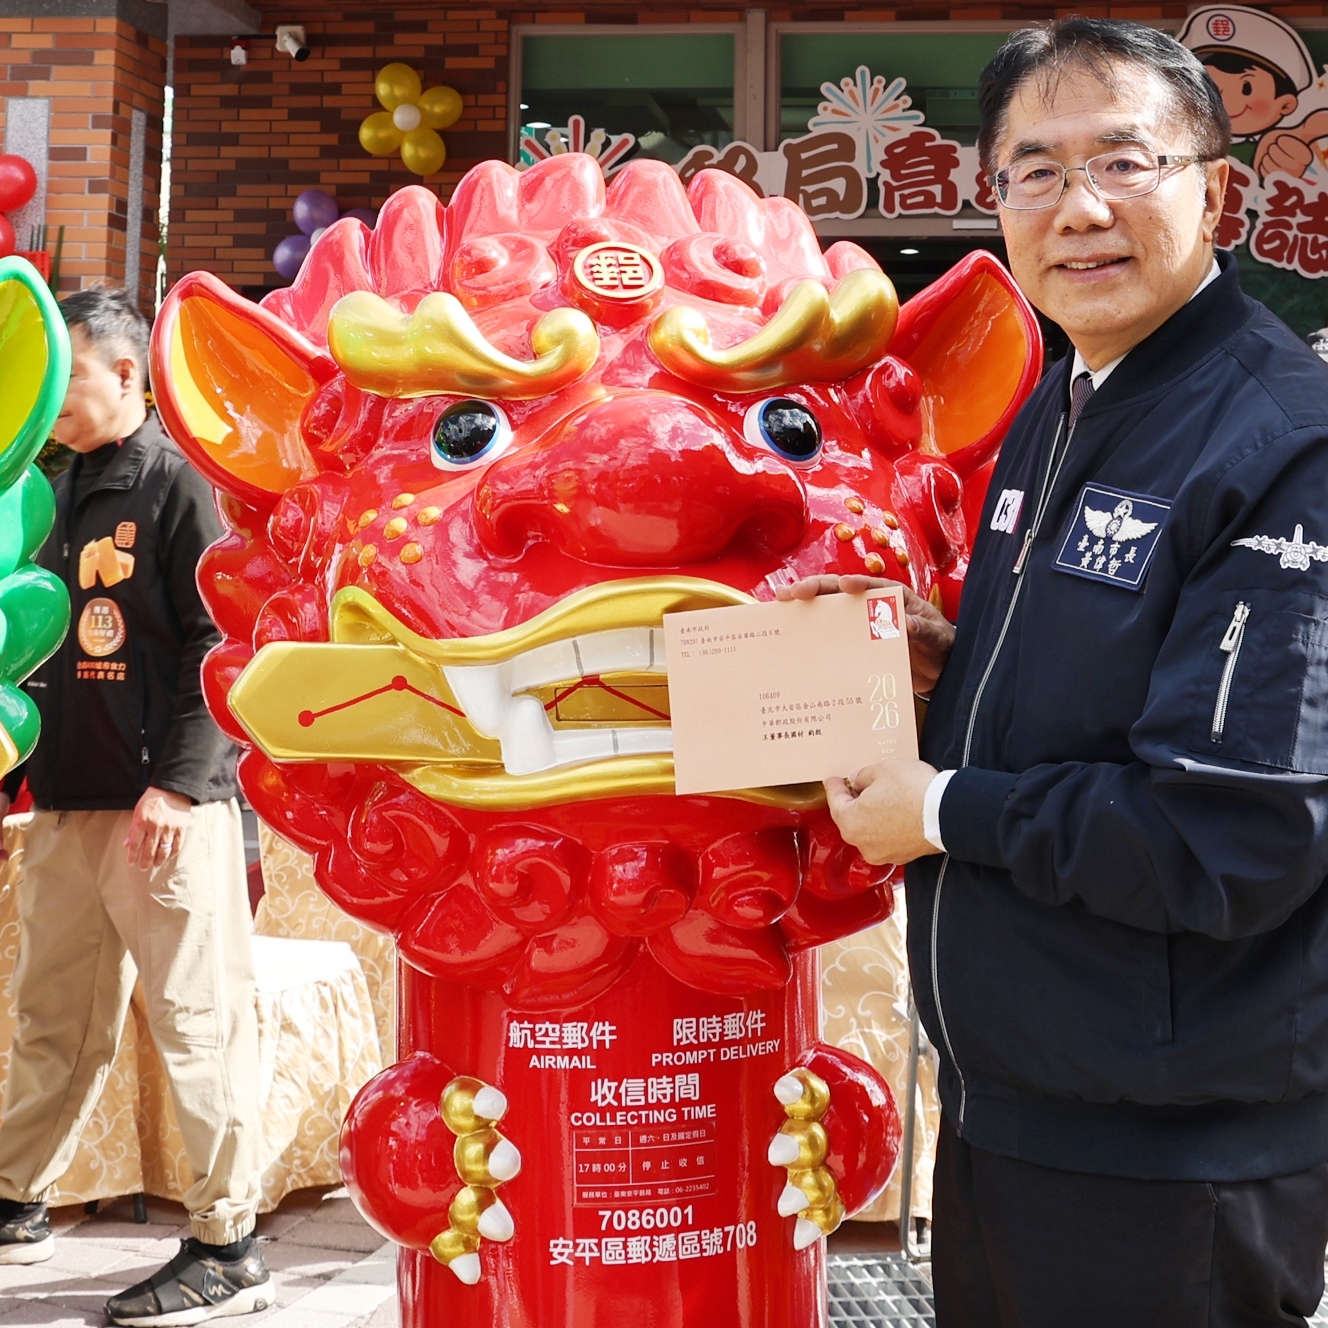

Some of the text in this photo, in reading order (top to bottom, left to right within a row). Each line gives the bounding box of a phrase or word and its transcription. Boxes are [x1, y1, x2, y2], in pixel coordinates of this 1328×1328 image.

[1076, 533, 1139, 564] 臺南市長
[1079, 551, 1122, 576] 黃偉哲
[90, 614, 113, 629] 113
[680, 624, 710, 635] 臺南市政府
[867, 672, 897, 703] 20
[761, 713, 832, 728] 中華郵政股份有限公司
[870, 701, 900, 731] 26
[508, 1020, 617, 1050] 航空郵件
[672, 1009, 767, 1047] 限時郵件
[528, 1055, 597, 1069] AIRMAIL
[651, 1039, 781, 1067] PROMPT DELIVERY
[589, 1072, 701, 1108] 收信時間
[571, 1103, 717, 1127] COLLECTING TIME
[598, 1205, 694, 1231] 7086001
[548, 1220, 757, 1266] 安平區郵遞區號708
